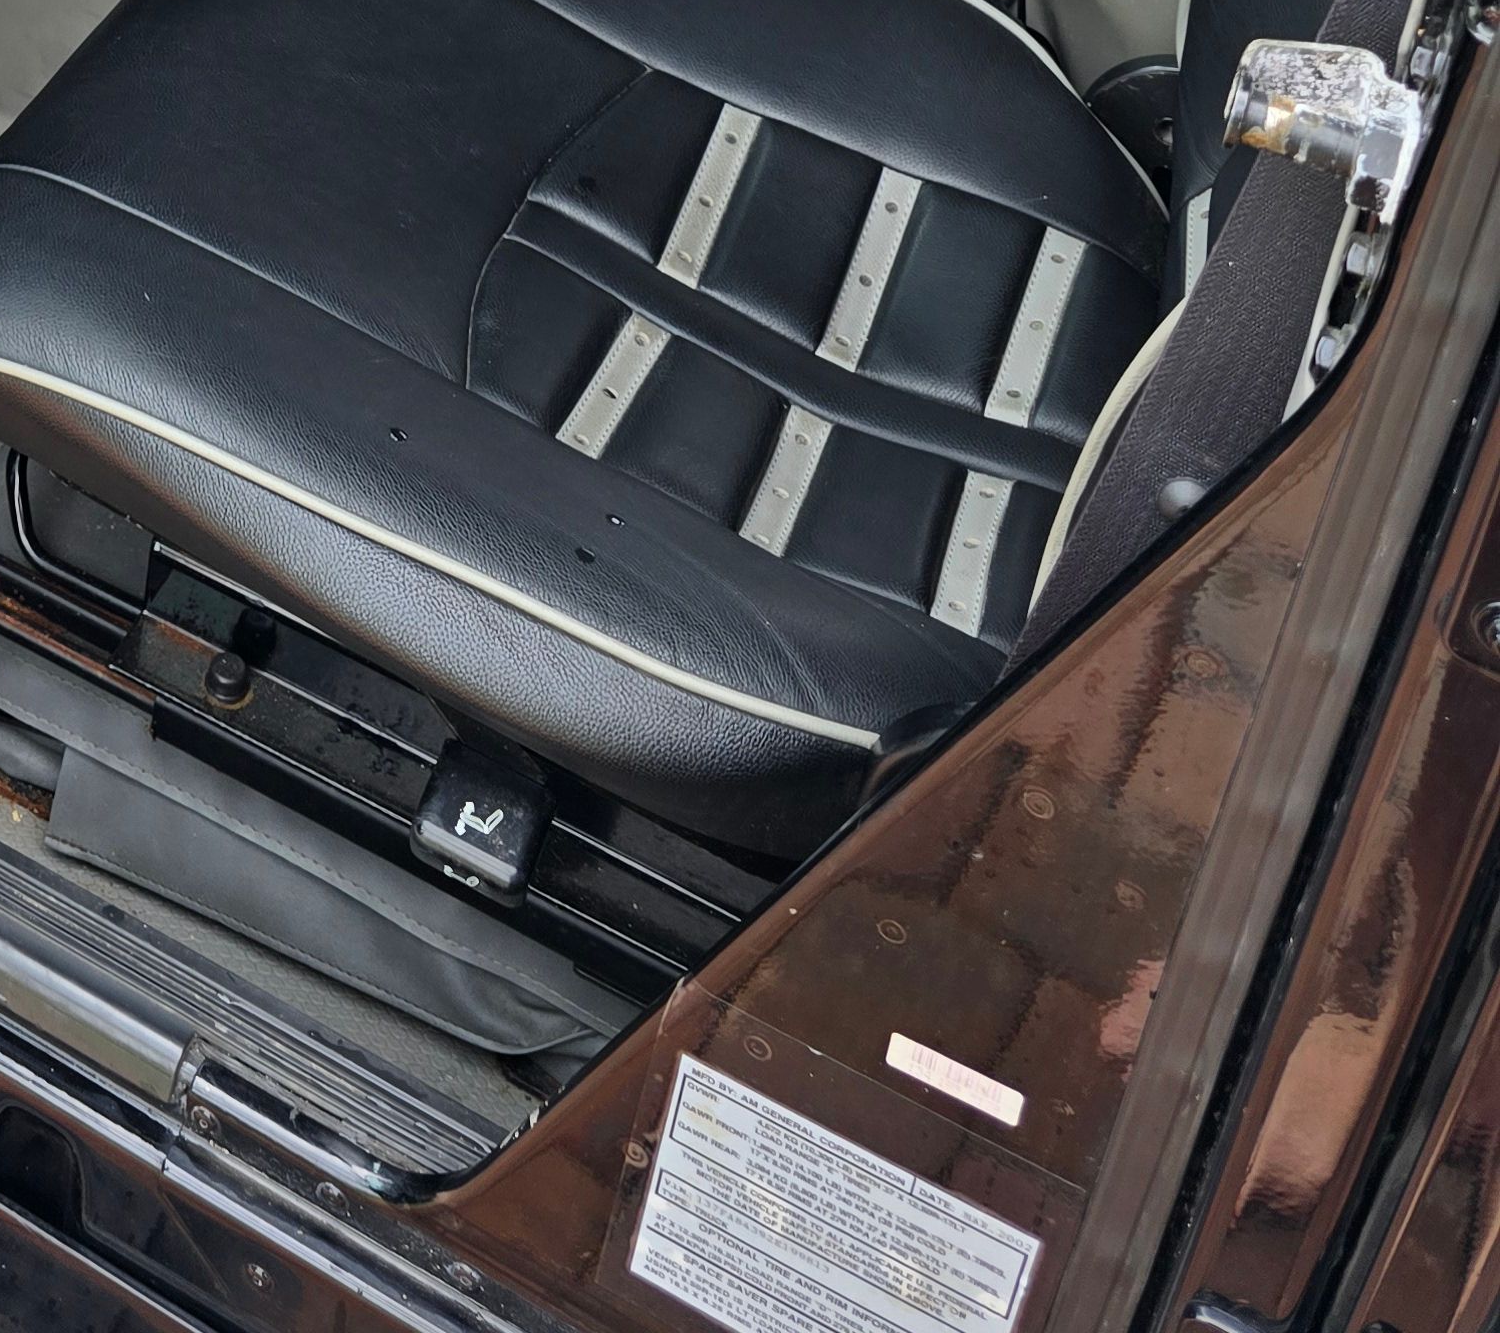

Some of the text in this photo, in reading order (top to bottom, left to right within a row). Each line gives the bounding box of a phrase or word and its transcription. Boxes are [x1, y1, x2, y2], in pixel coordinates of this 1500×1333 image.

[691, 1067, 715, 1085] MFD
[718, 1081, 737, 1097] BY:
[740, 1093, 758, 1108] AM
[761, 1104, 815, 1138] GENERAL
[818, 1135, 906, 1186] CORPORATION
[754, 1126, 783, 1147] LOAD
[784, 1143, 820, 1167] RANGE
[777, 1152, 793, 1166] KG
[783, 1132, 798, 1146] KG
[749, 1147, 761, 1158] 17
[819, 1184, 833, 1196] AT
[915, 1235, 946, 1257] COLD
[772, 1171, 788, 1185] KG
[681, 1151, 704, 1168] THIS
[705, 1164, 748, 1192] VEHICLE
[749, 1188, 807, 1224] CONFORMS
[809, 1220, 824, 1234] TO
[826, 1230, 844, 1245] ALL
[848, 1242, 914, 1281] APPLICABLE
[937, 1289, 987, 1321] FEDERAL
[694, 1206, 729, 1229] TRUCK
[695, 1168, 966, 1320] MOTOR VEHICLE SAFETY STANDARDS IN EFFECT ON
[710, 1185, 731, 1202] THE
[733, 1198, 760, 1218] DATE
[762, 1214, 777, 1227] OF
[779, 1224, 859, 1272] MANUFACTURE
[862, 1268, 902, 1295] SHOWN
[744, 1166, 755, 1177] 17
[813, 1204, 828, 1216] AT
[910, 1255, 941, 1277] COLD
[643, 1263, 665, 1279] AND
[644, 1254, 678, 1278] USING
[736, 1306, 749, 1318] LT
[646, 1246, 692, 1276] VEHICLE
[694, 1273, 730, 1299] SPEED
[732, 1295, 743, 1306] IS
[653, 1220, 666, 1232] AT
[686, 1238, 707, 1255] KPA
[743, 1270, 772, 1292] COLD
[772, 1287, 809, 1312] FRONT
[809, 1307, 831, 1324] AND
[682, 1253, 814, 1332] SPACE SAVER SPARE
[697, 1222, 760, 1263] OPTIONAL
[762, 1258, 791, 1280] TIRE
[793, 1275, 822, 1297] AND
[825, 1292, 849, 1311] RIM
[744, 1262, 774, 1283] LOAD
[775, 1279, 812, 1304] RANGE
